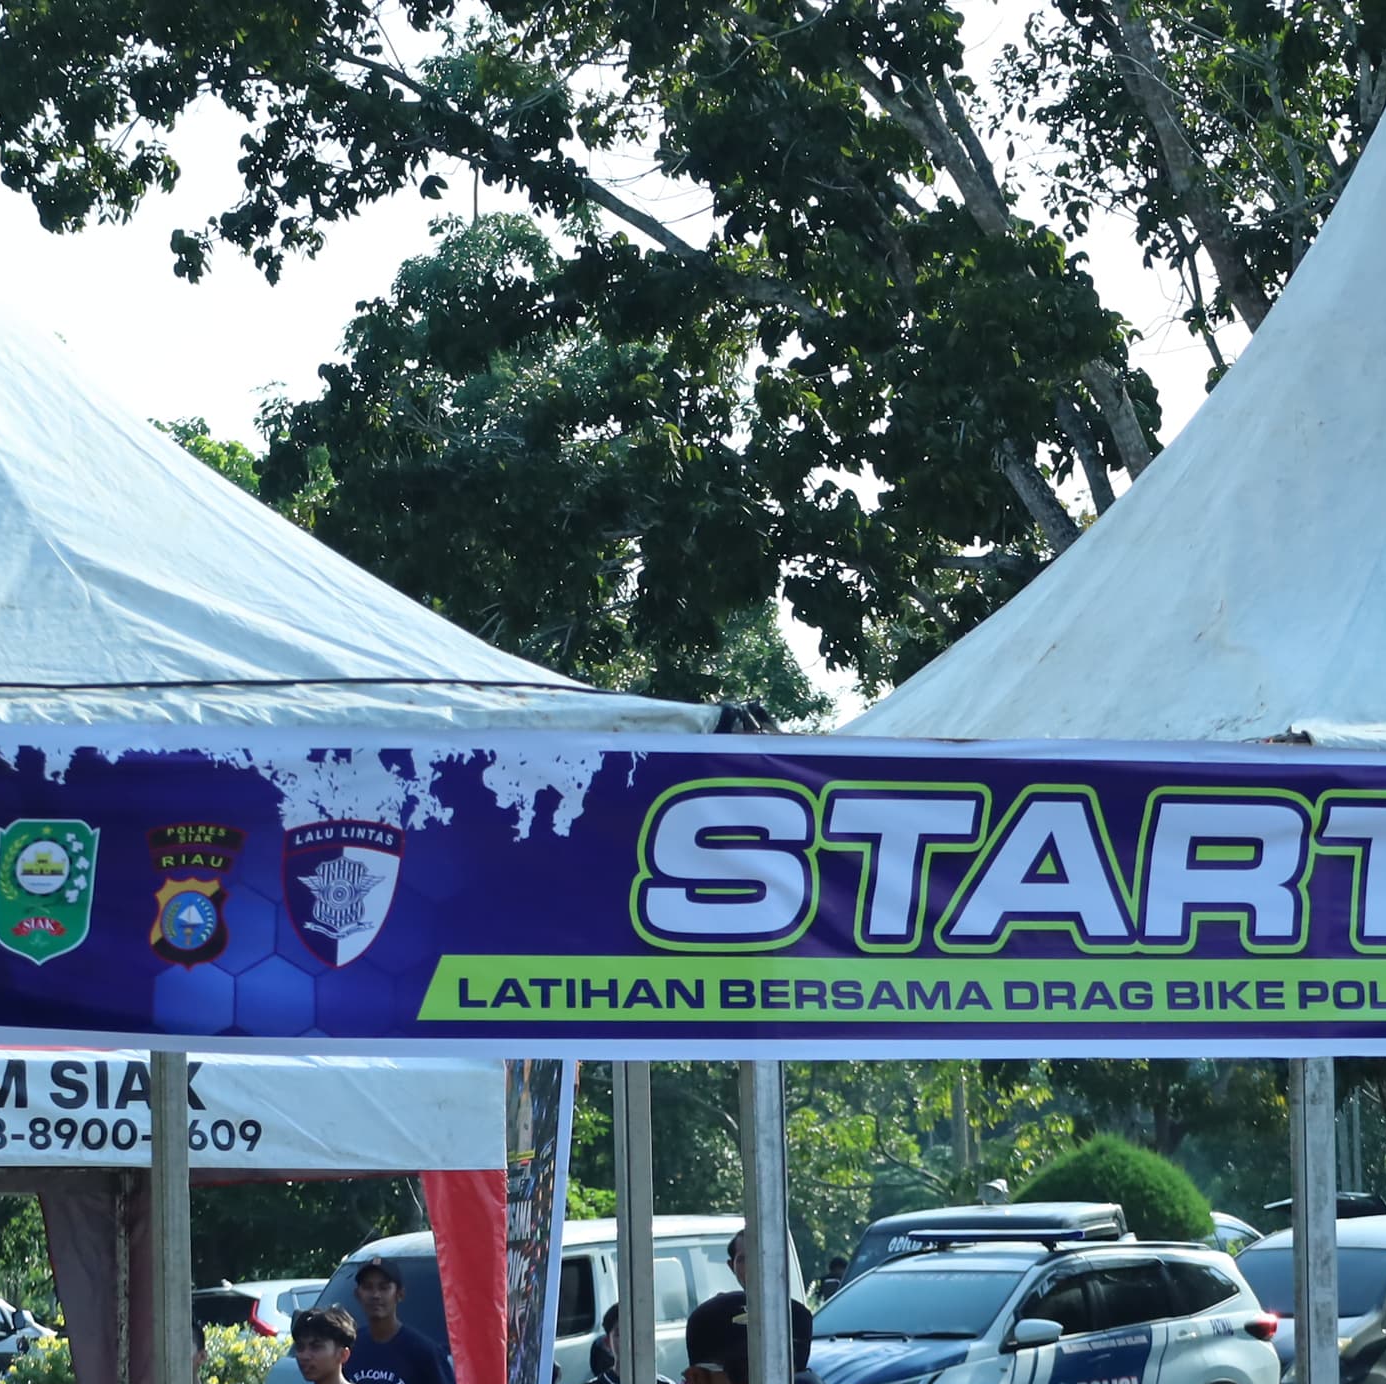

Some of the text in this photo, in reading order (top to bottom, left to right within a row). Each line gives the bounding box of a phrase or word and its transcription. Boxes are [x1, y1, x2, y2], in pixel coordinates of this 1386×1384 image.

[166, 825, 227, 837] POLRES
[178, 833, 213, 844] SIAK
[295, 825, 395, 846] LALU LINTAS
[161, 853, 224, 868] RIAU
[22, 917, 56, 932] SIAK
[458, 977, 704, 1009] LATIHAN
[721, 978, 993, 1010] BERSAMA
[1004, 980, 1153, 1010] DRAG
[1166, 980, 1285, 1010] BIKE
[49, 1058, 207, 1111] SIAK
